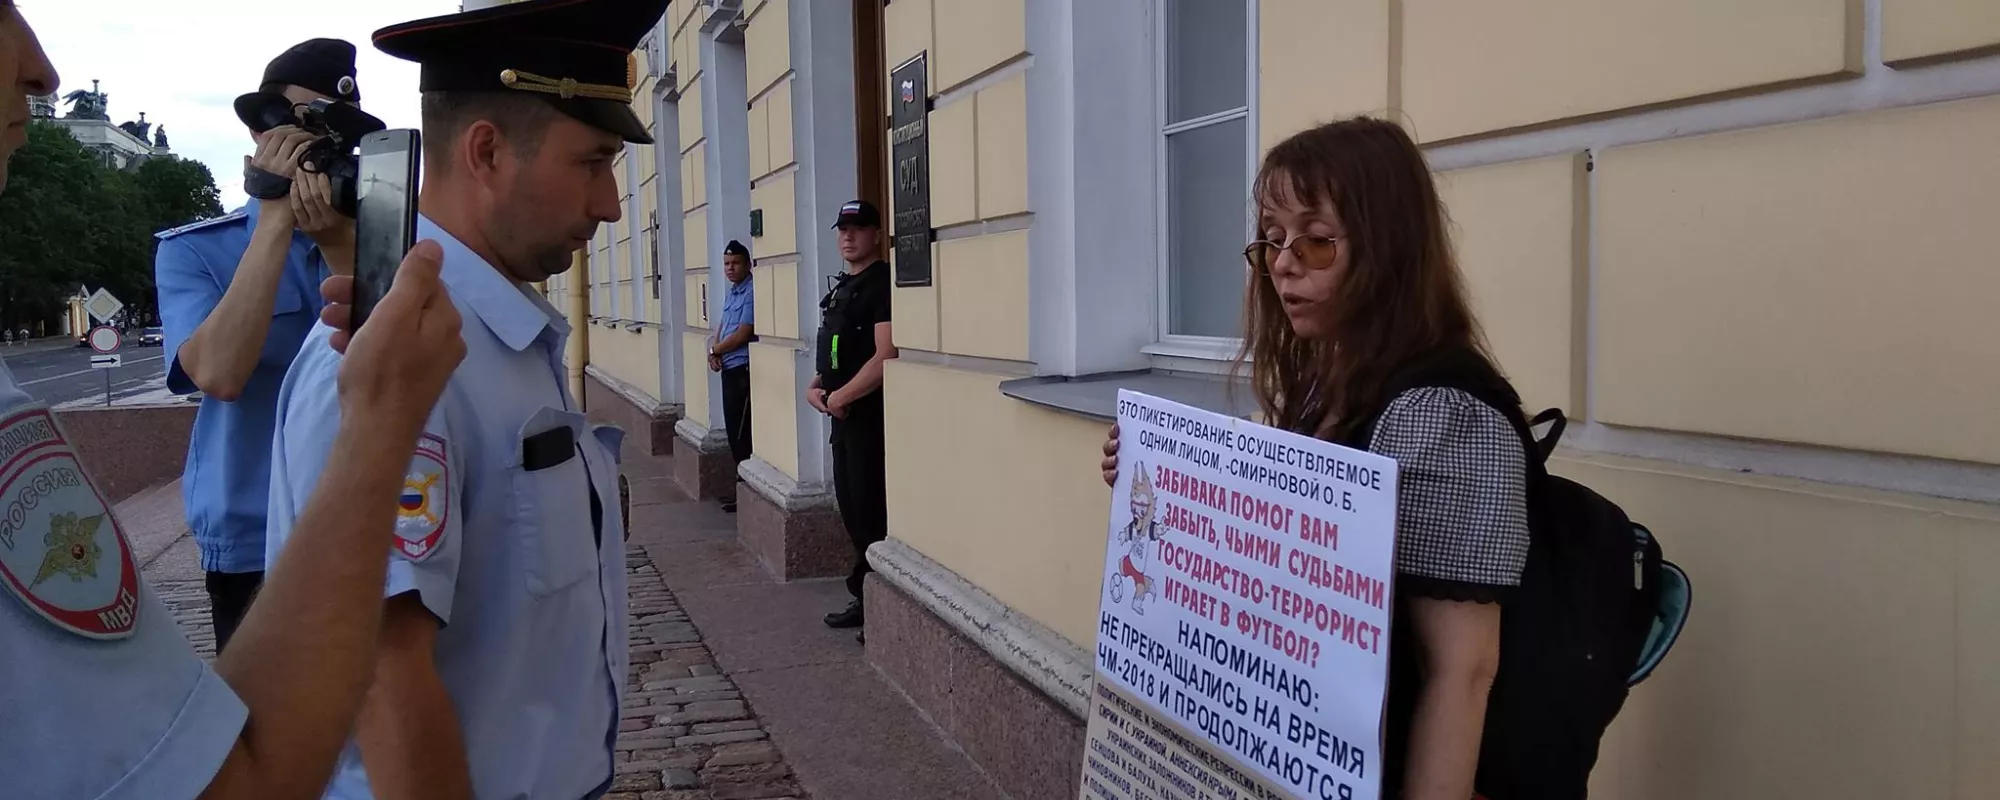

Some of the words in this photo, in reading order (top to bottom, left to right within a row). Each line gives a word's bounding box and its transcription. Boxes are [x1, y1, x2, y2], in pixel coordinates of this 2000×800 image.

[901, 157, 917, 194] СУД
[1119, 400, 1138, 418] ЭТО
[1237, 434, 1381, 491] ОСУЩЕСТВЛЯЕМОЕ
[1140, 430, 1177, 456] ОДНИМ
[1178, 443, 1223, 474] ЛИЦОМ,
[1226, 458, 1319, 501] -СМИРНОВОЙ
[1323, 486, 1338, 507] О.
[1342, 491, 1357, 513] Б.
[0, 467, 80, 551] РОССИЯ
[1155, 465, 1227, 513] ЗАБИВАКА
[1230, 491, 1294, 534] ПОМОГ
[1300, 513, 1339, 552] ВАМ
[1157, 537, 1382, 655] ГОСУДАРСТВО-ТЕРРОРИСТ
[1163, 502, 1220, 550] ЗАБЫТЬ,
[1225, 524, 1281, 569] ЧЬИМИ
[1288, 548, 1385, 610] СУДЬБАМИ
[98, 587, 136, 630] МВД
[1164, 576, 1217, 621] ИГРАЕТ
[1220, 601, 1231, 627] В
[1236, 609, 1320, 669] ФУТБОЛ?
[1100, 610, 1120, 641] НЕ
[1120, 622, 1248, 717] ПРЕКРАЩАЛИСЬ
[1253, 695, 1281, 735] НА
[1287, 712, 1364, 780] ВРЕМЯ
[1177, 619, 1319, 713] НАПОМИНАЮ:
[1098, 642, 1155, 698] ЧМ-2018
[1159, 680, 1170, 709] И
[1174, 690, 1353, 800] ПРОДОЛЖАЮТСЯ
